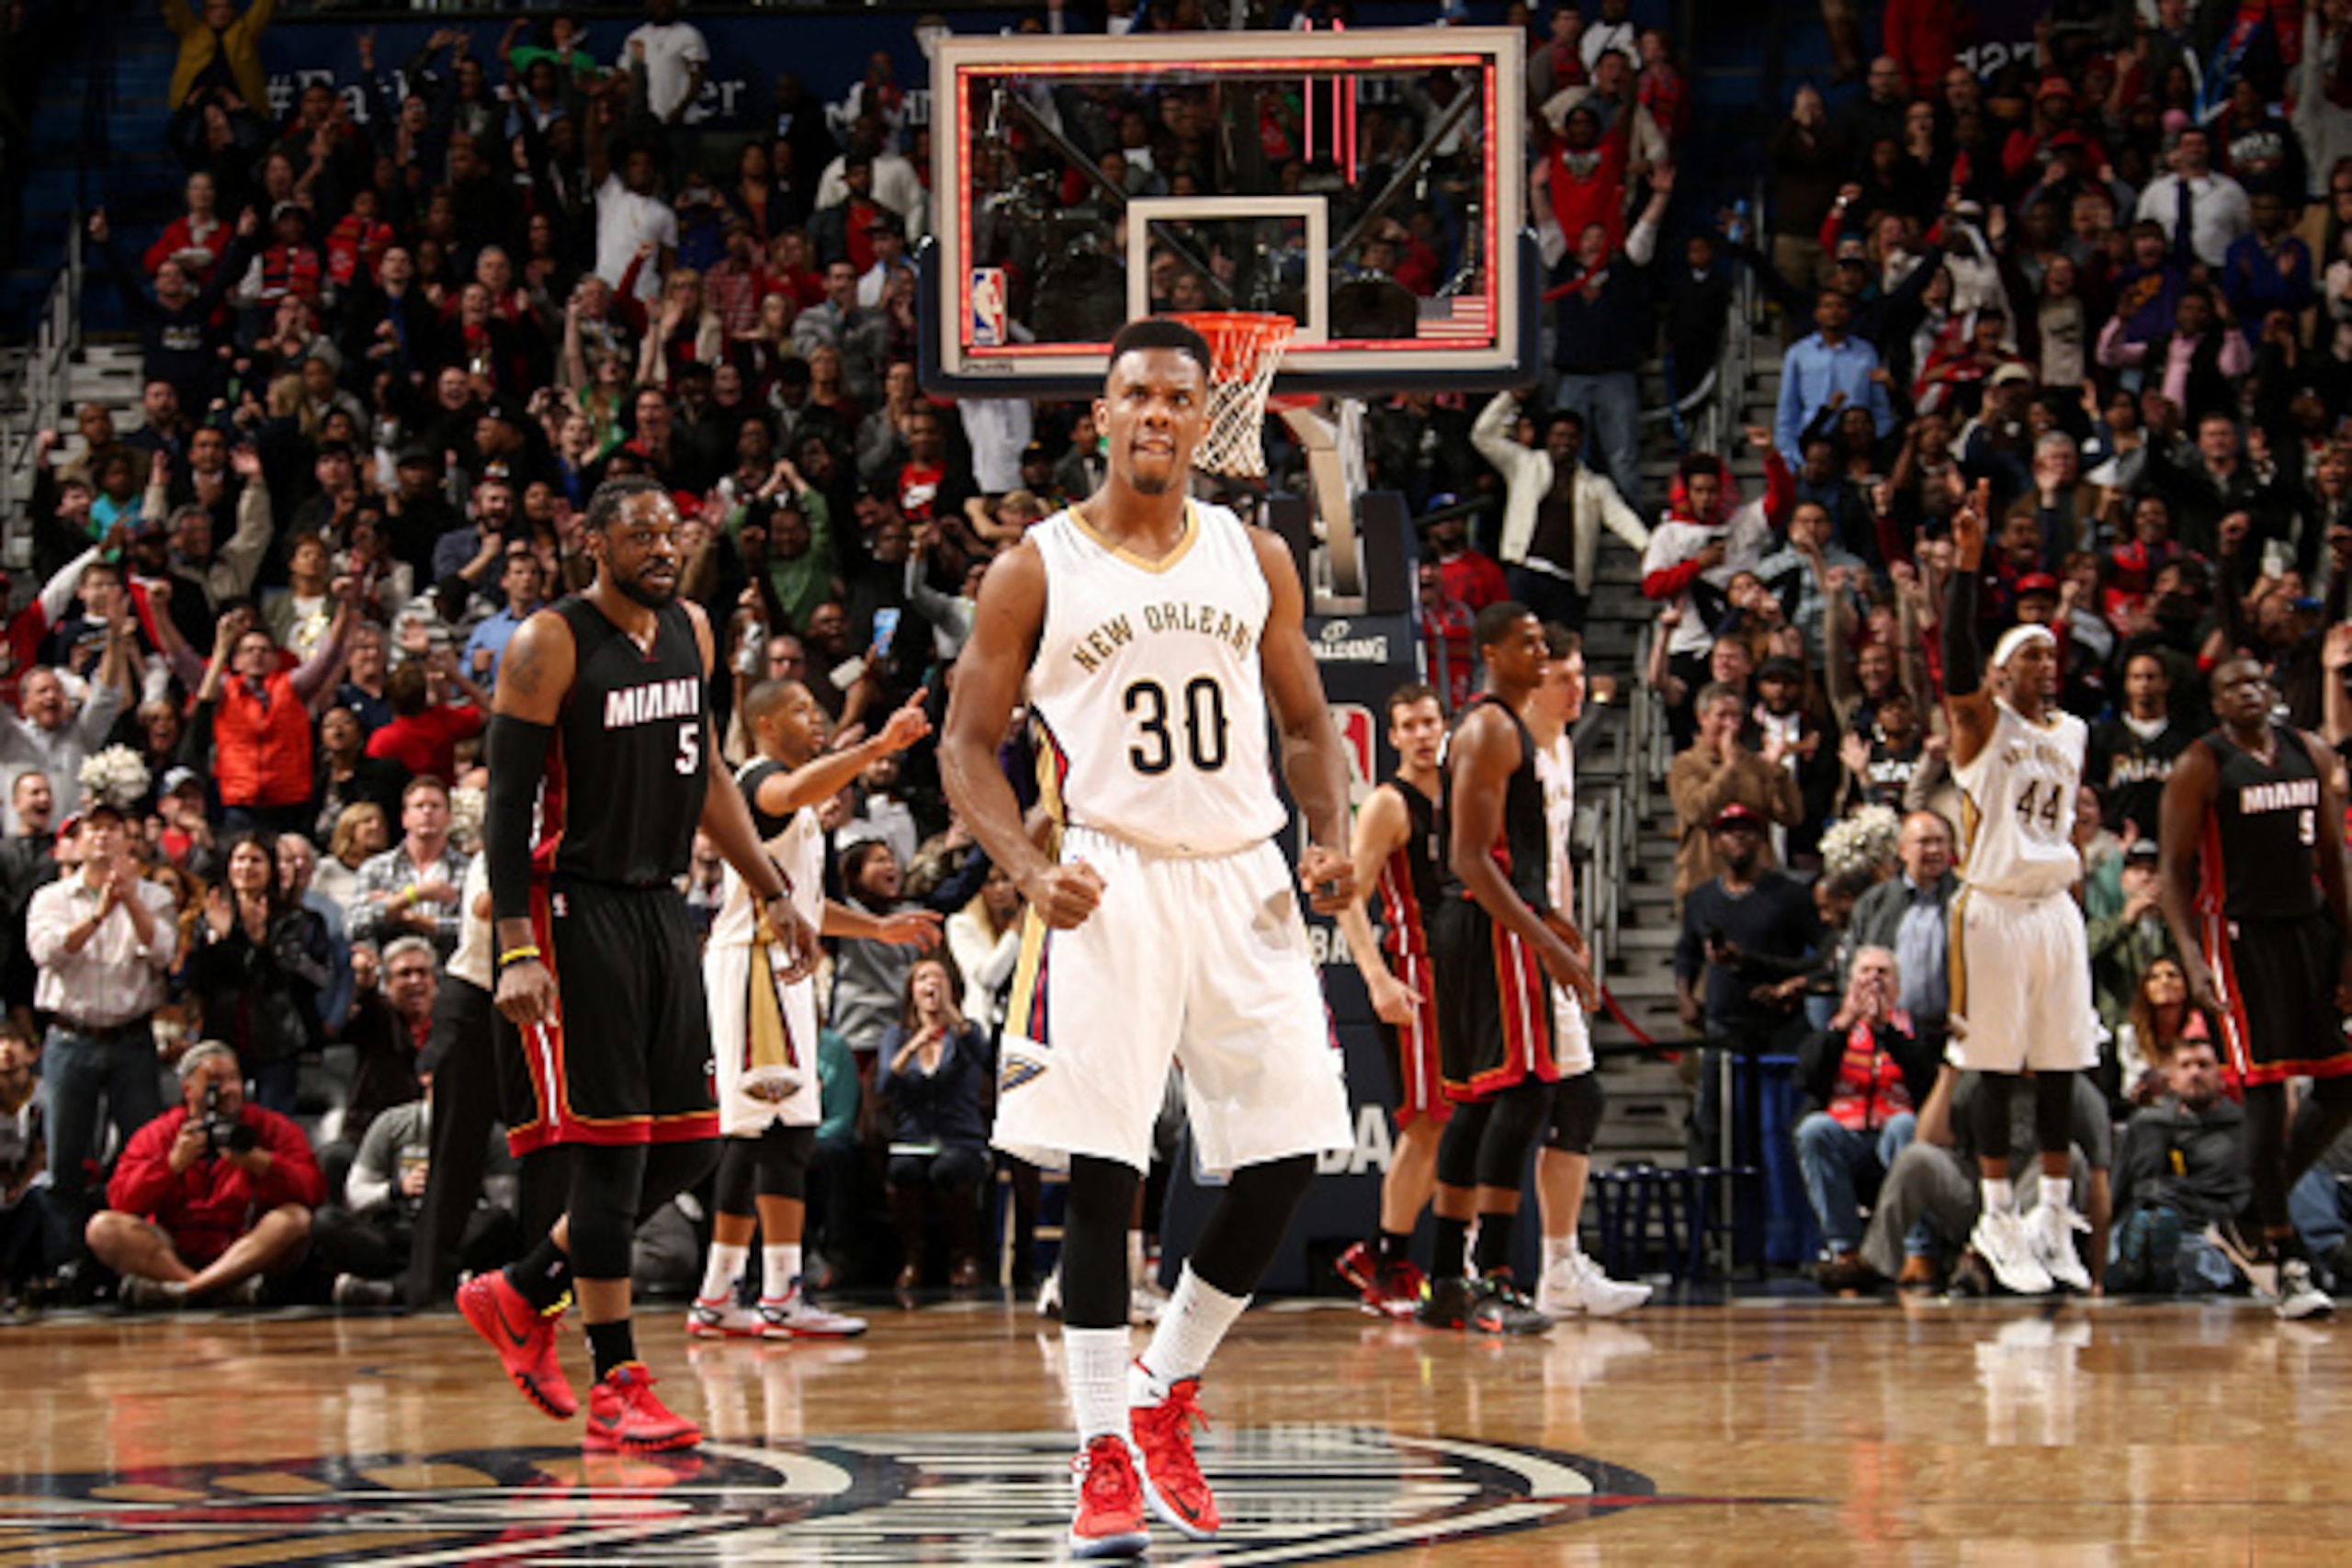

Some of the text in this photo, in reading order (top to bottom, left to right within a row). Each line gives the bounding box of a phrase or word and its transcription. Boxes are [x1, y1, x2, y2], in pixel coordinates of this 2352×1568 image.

[1072, 602, 1252, 673] NEW ORLEAN
[1309, 635, 1388, 663] ALDING
[604, 677, 699, 730] MIAMI
[1123, 674, 1229, 775] 30
[674, 722, 699, 774] 5
[2015, 777, 2063, 830] 44
[2240, 779, 2319, 814] MIAMI
